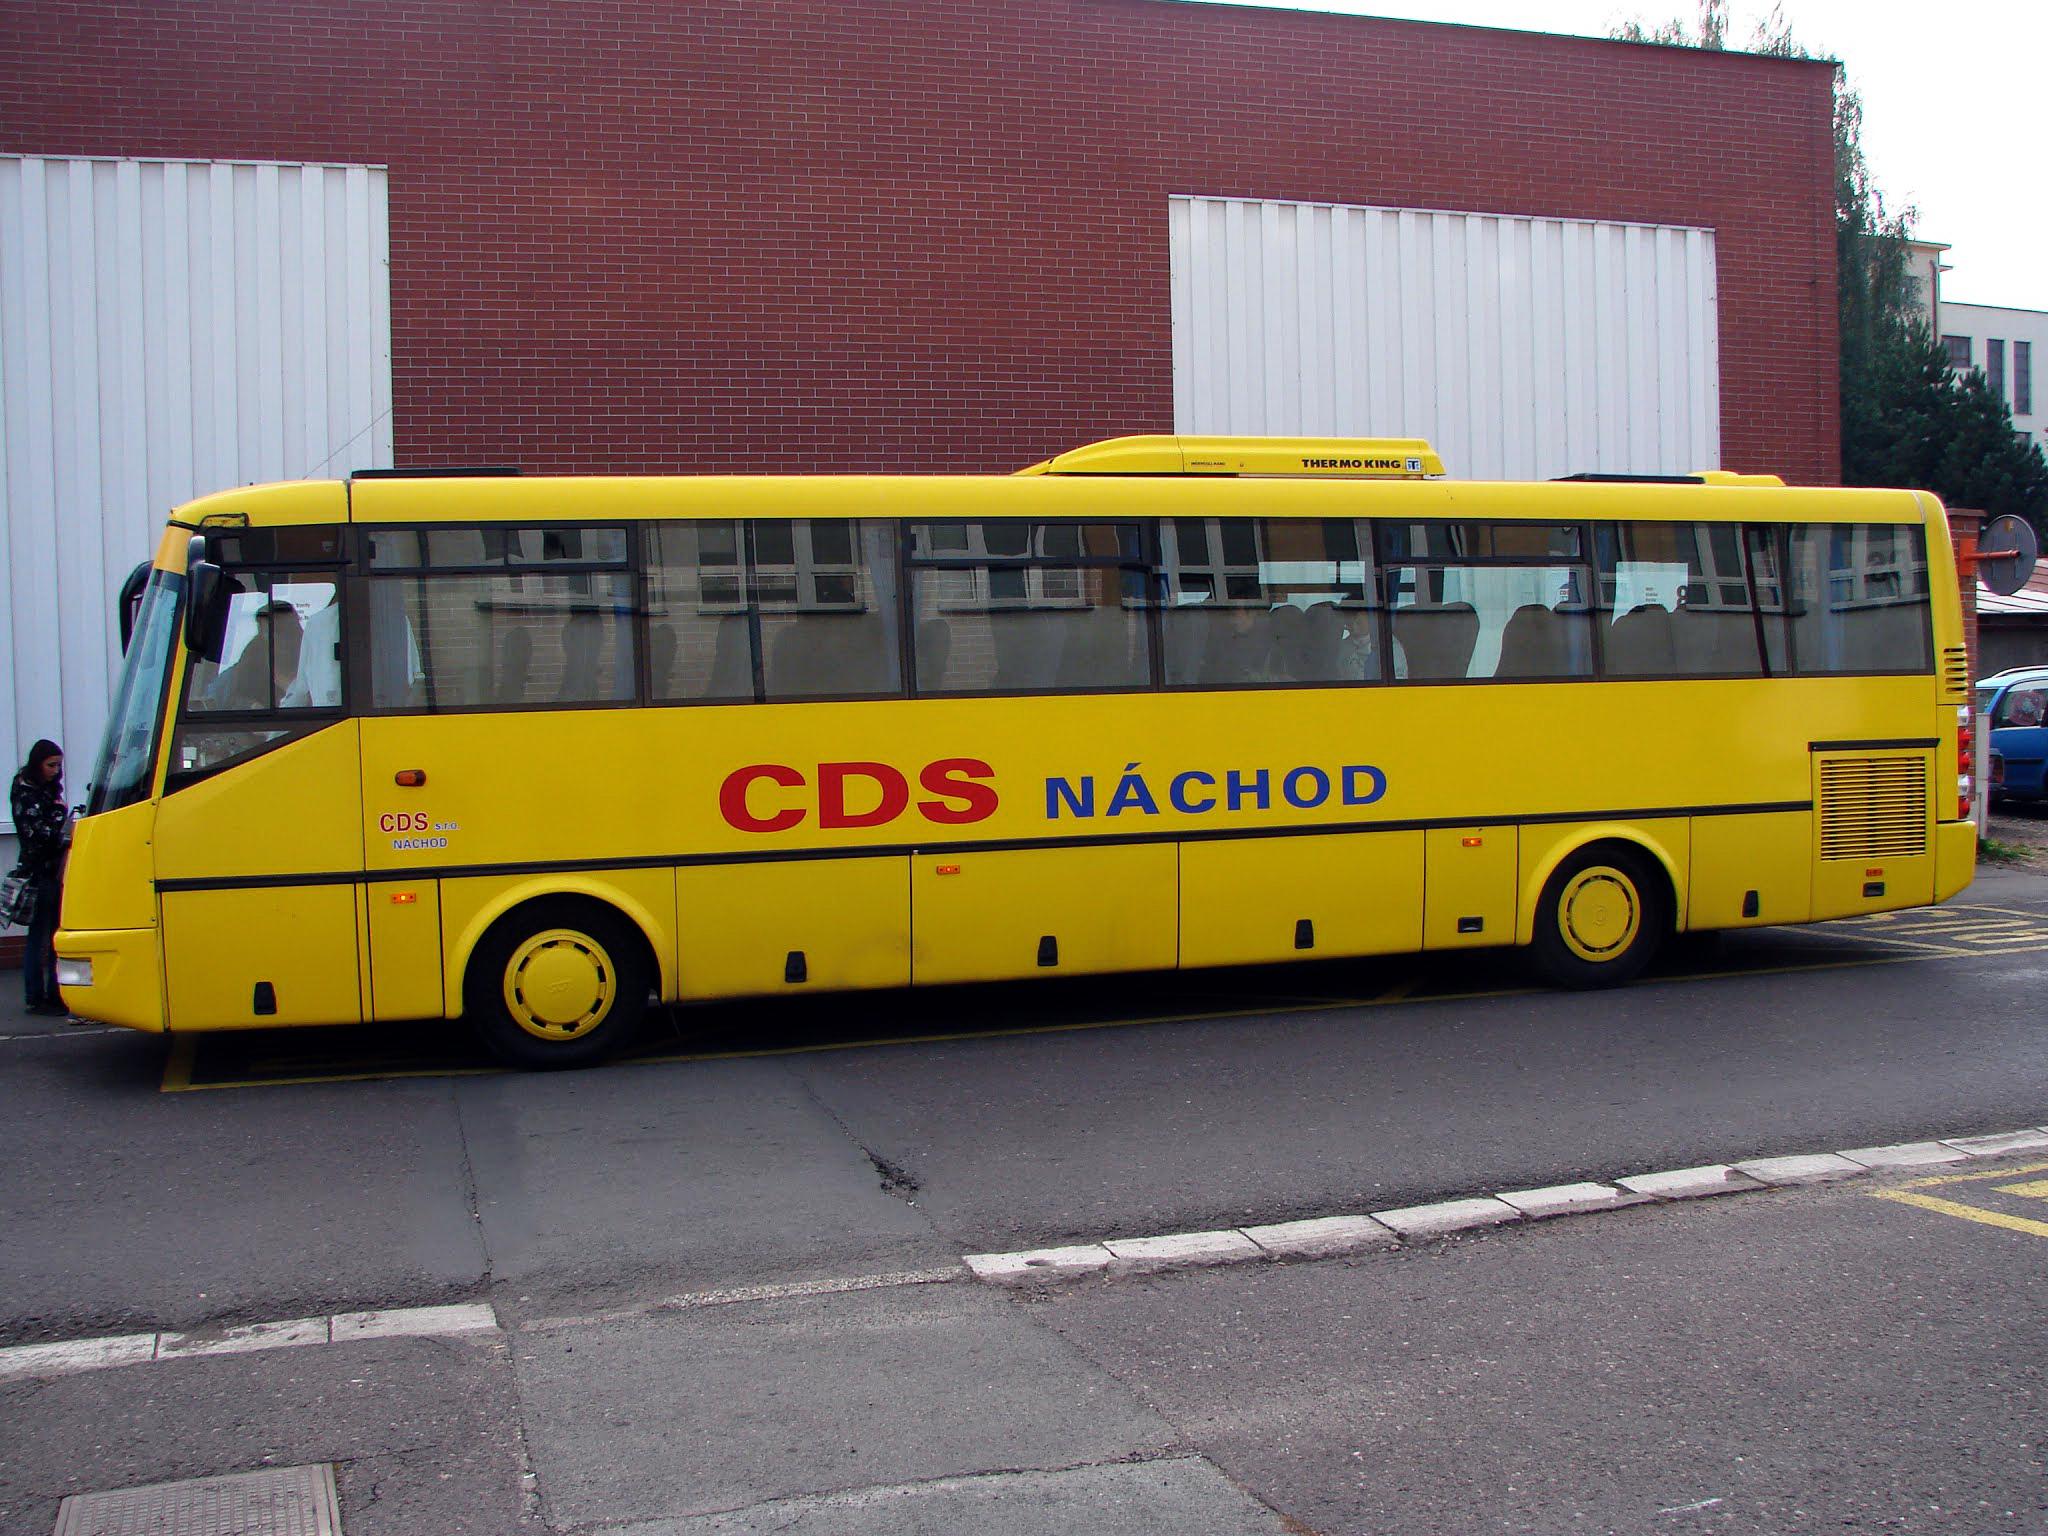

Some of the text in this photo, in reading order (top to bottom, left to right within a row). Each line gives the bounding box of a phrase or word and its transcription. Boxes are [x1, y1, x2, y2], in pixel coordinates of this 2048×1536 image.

[1301, 459, 1401, 469] THERMO KING
[719, 758, 1386, 832] CDS NÁCHOD
[380, 812, 428, 832] CDS
